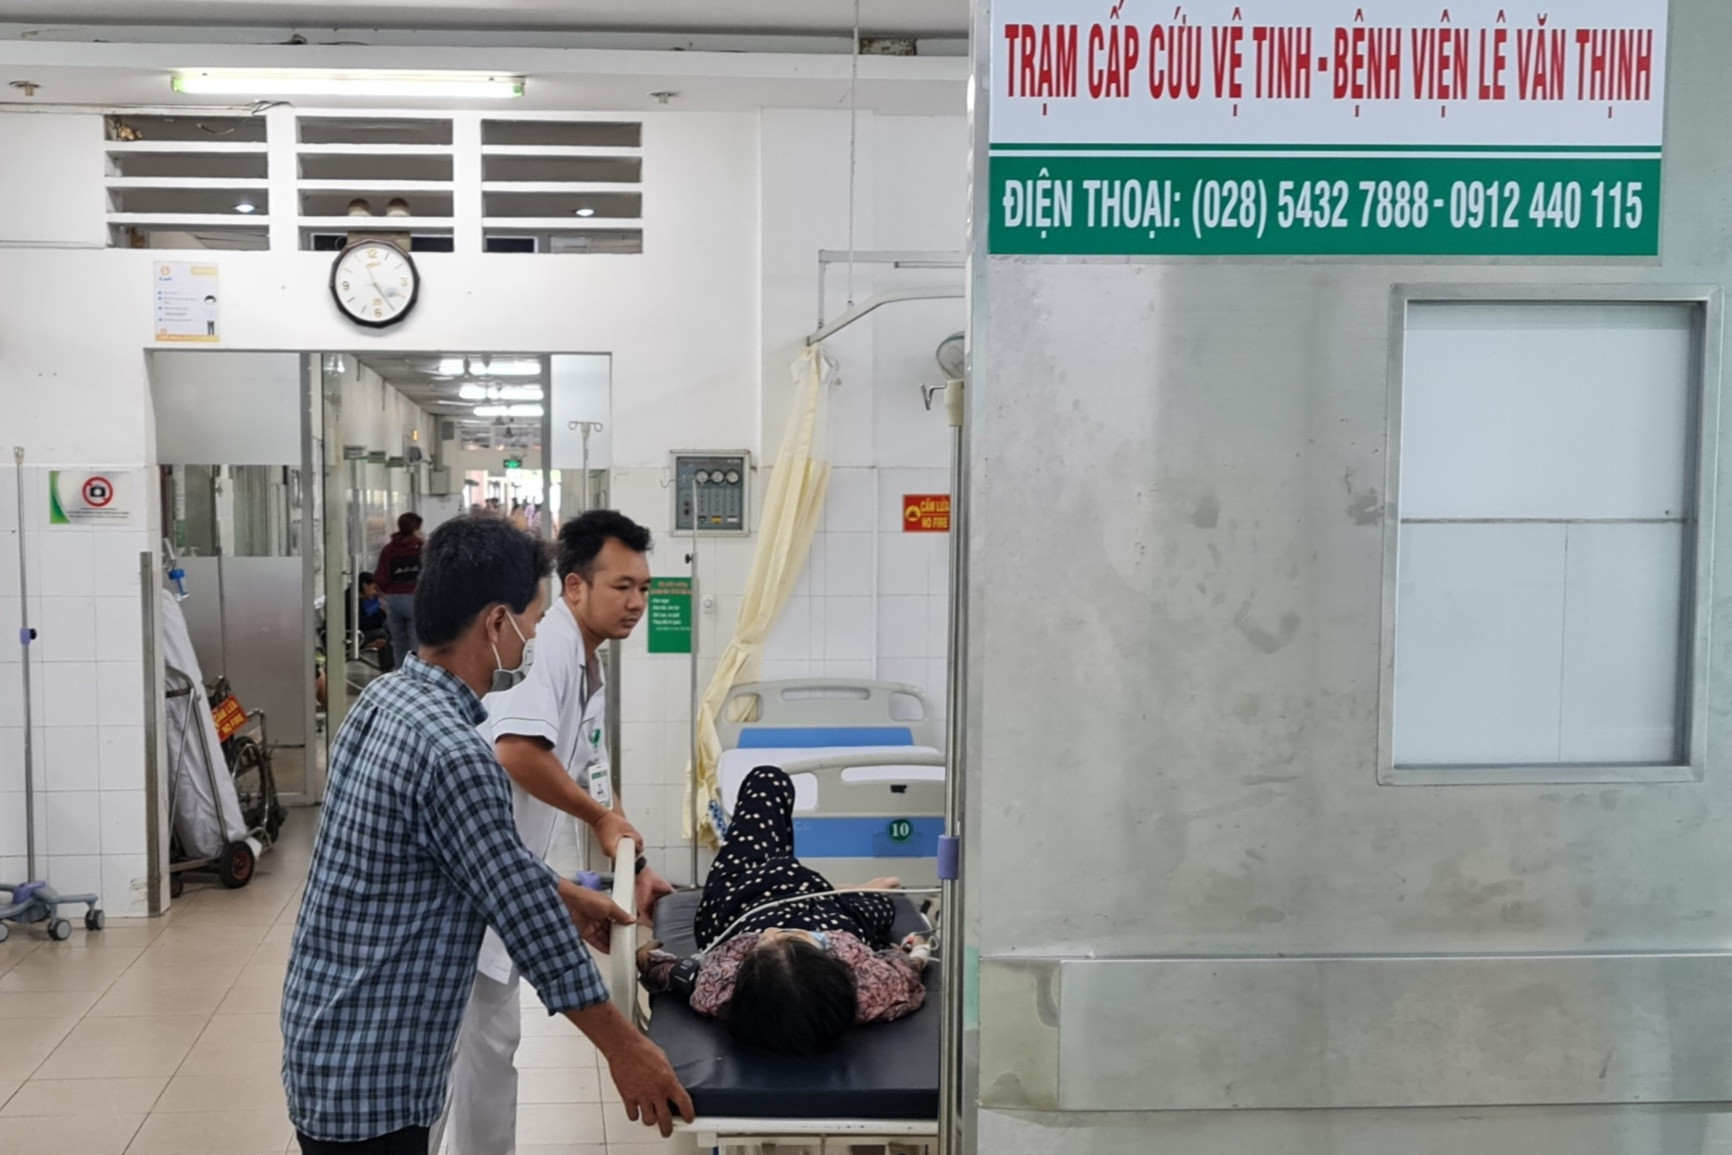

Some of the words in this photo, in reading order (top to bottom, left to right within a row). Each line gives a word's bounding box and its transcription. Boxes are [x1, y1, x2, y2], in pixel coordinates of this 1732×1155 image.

[1004, 24, 1078, 116] TRẠM
[1088, 0, 1140, 100] CẤP
[1149, 6, 1202, 100] CỨU
[1212, 7, 1243, 117] VỆ
[1252, 26, 1312, 99] TINH
[1333, 8, 1402, 118] BỆNH
[1411, 9, 1469, 118] VIỆN
[1478, 9, 1507, 101] LÊ
[1516, 13, 1566, 101] VĂN
[1575, 28, 1653, 119] THỊNH
[1003, 167, 1073, 239] ĐIỆN
[1082, 178, 1181, 239] THOẠI:
[1192, 178, 1267, 239] (028)
[1278, 180, 1349, 229] 5432
[1528, 181, 1582, 229] 440
[1591, 181, 1643, 229] 115
[366, 249, 378, 258] 12
[342, 281, 350, 291] 9
[400, 277, 408, 287] 3
[922, 517, 932, 528] NO
[933, 517, 948, 528] FIRE
[892, 822, 910, 837] 10
